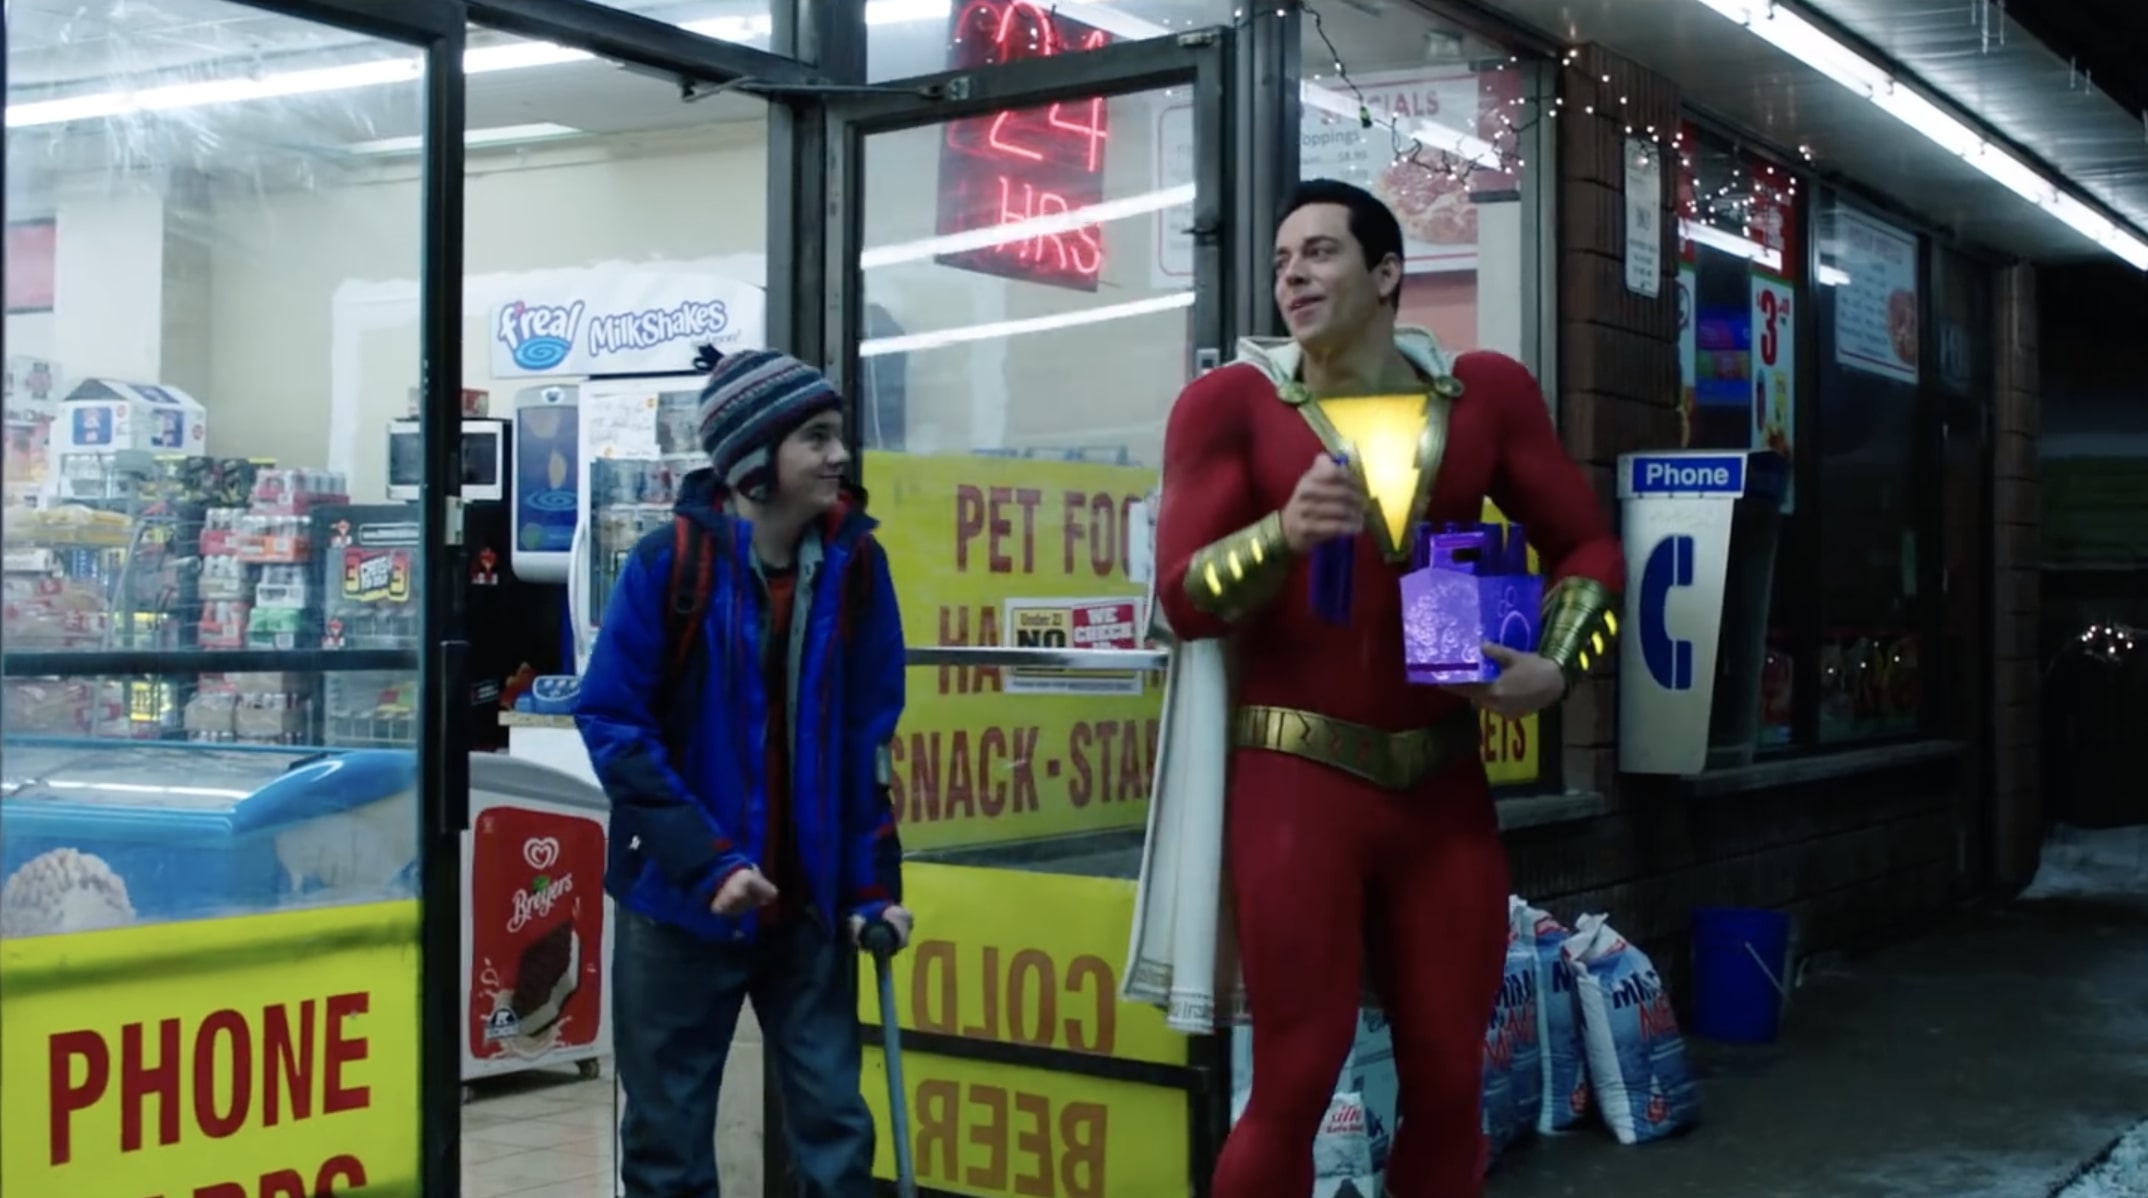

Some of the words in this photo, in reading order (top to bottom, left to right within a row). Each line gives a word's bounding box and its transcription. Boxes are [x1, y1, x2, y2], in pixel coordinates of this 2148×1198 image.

[988, 1, 1107, 173] 24
[1301, 130, 1360, 148] oppings
[996, 176, 1103, 275] HRS
[1646, 463, 1729, 486] Phone
[957, 484, 1041, 574] PET
[1482, 704, 1527, 763] ETS
[507, 873, 573, 932] Breyers
[49, 991, 370, 1166] PHONE
